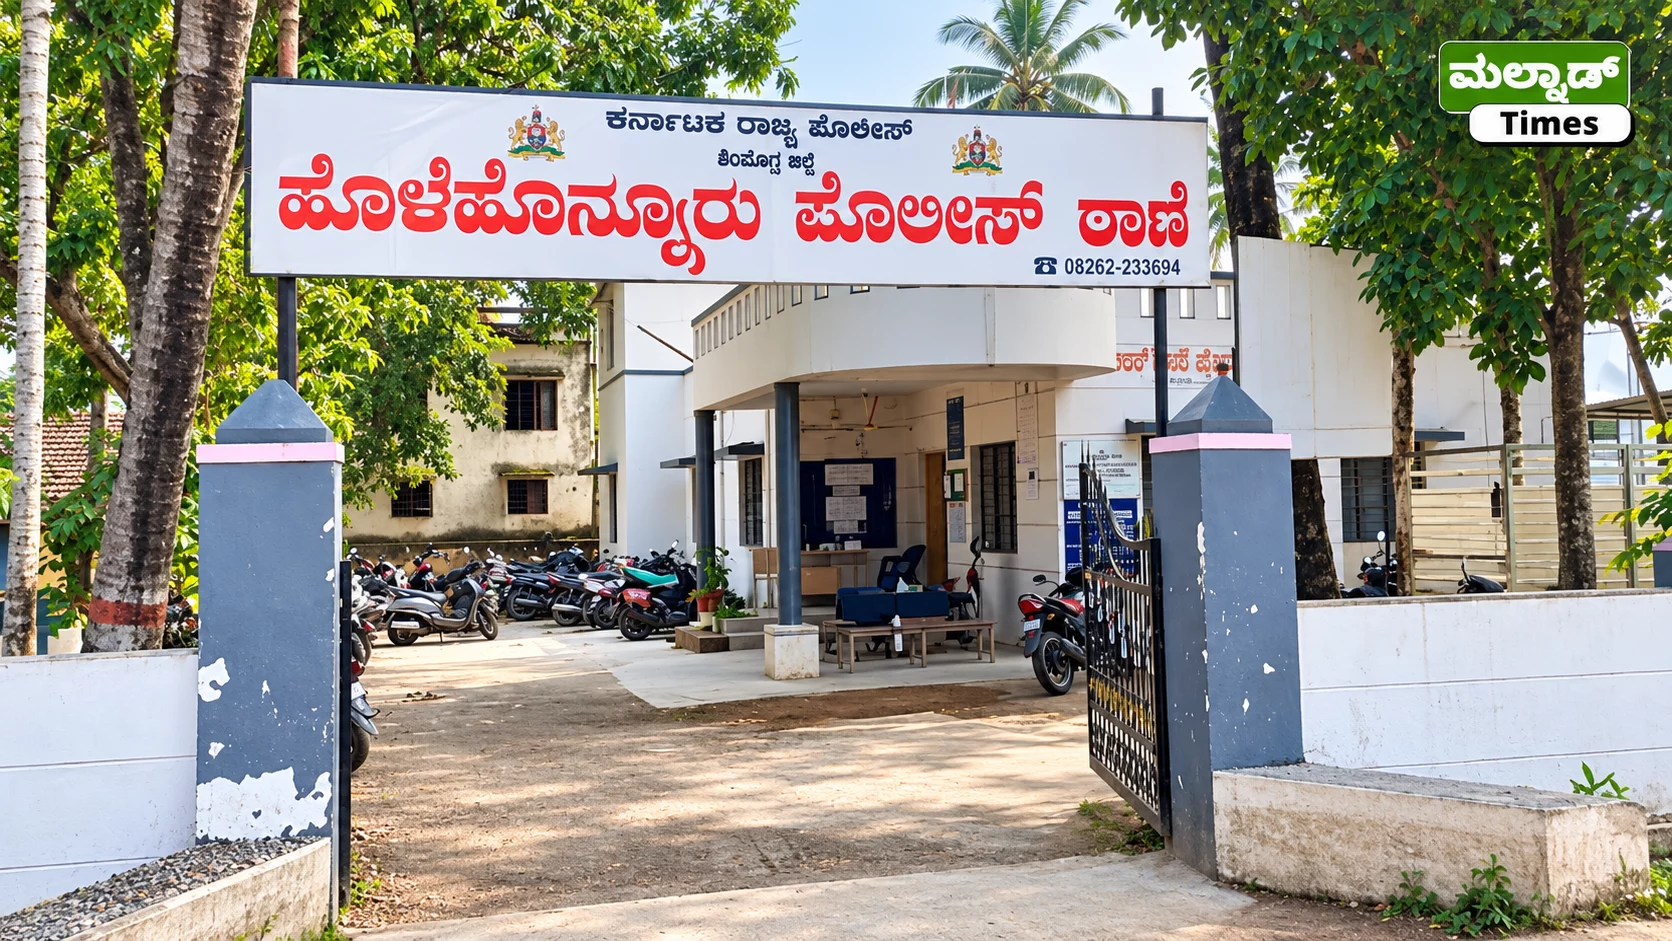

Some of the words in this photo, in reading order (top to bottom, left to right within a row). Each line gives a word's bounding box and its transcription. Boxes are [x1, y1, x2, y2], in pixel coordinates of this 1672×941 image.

[606, 106, 725, 134] ಕರ್ನಾಟಕ
[1078, 180, 1188, 248] ಠಾಣೆ
[1064, 258, 1181, 276] 08262-233694
